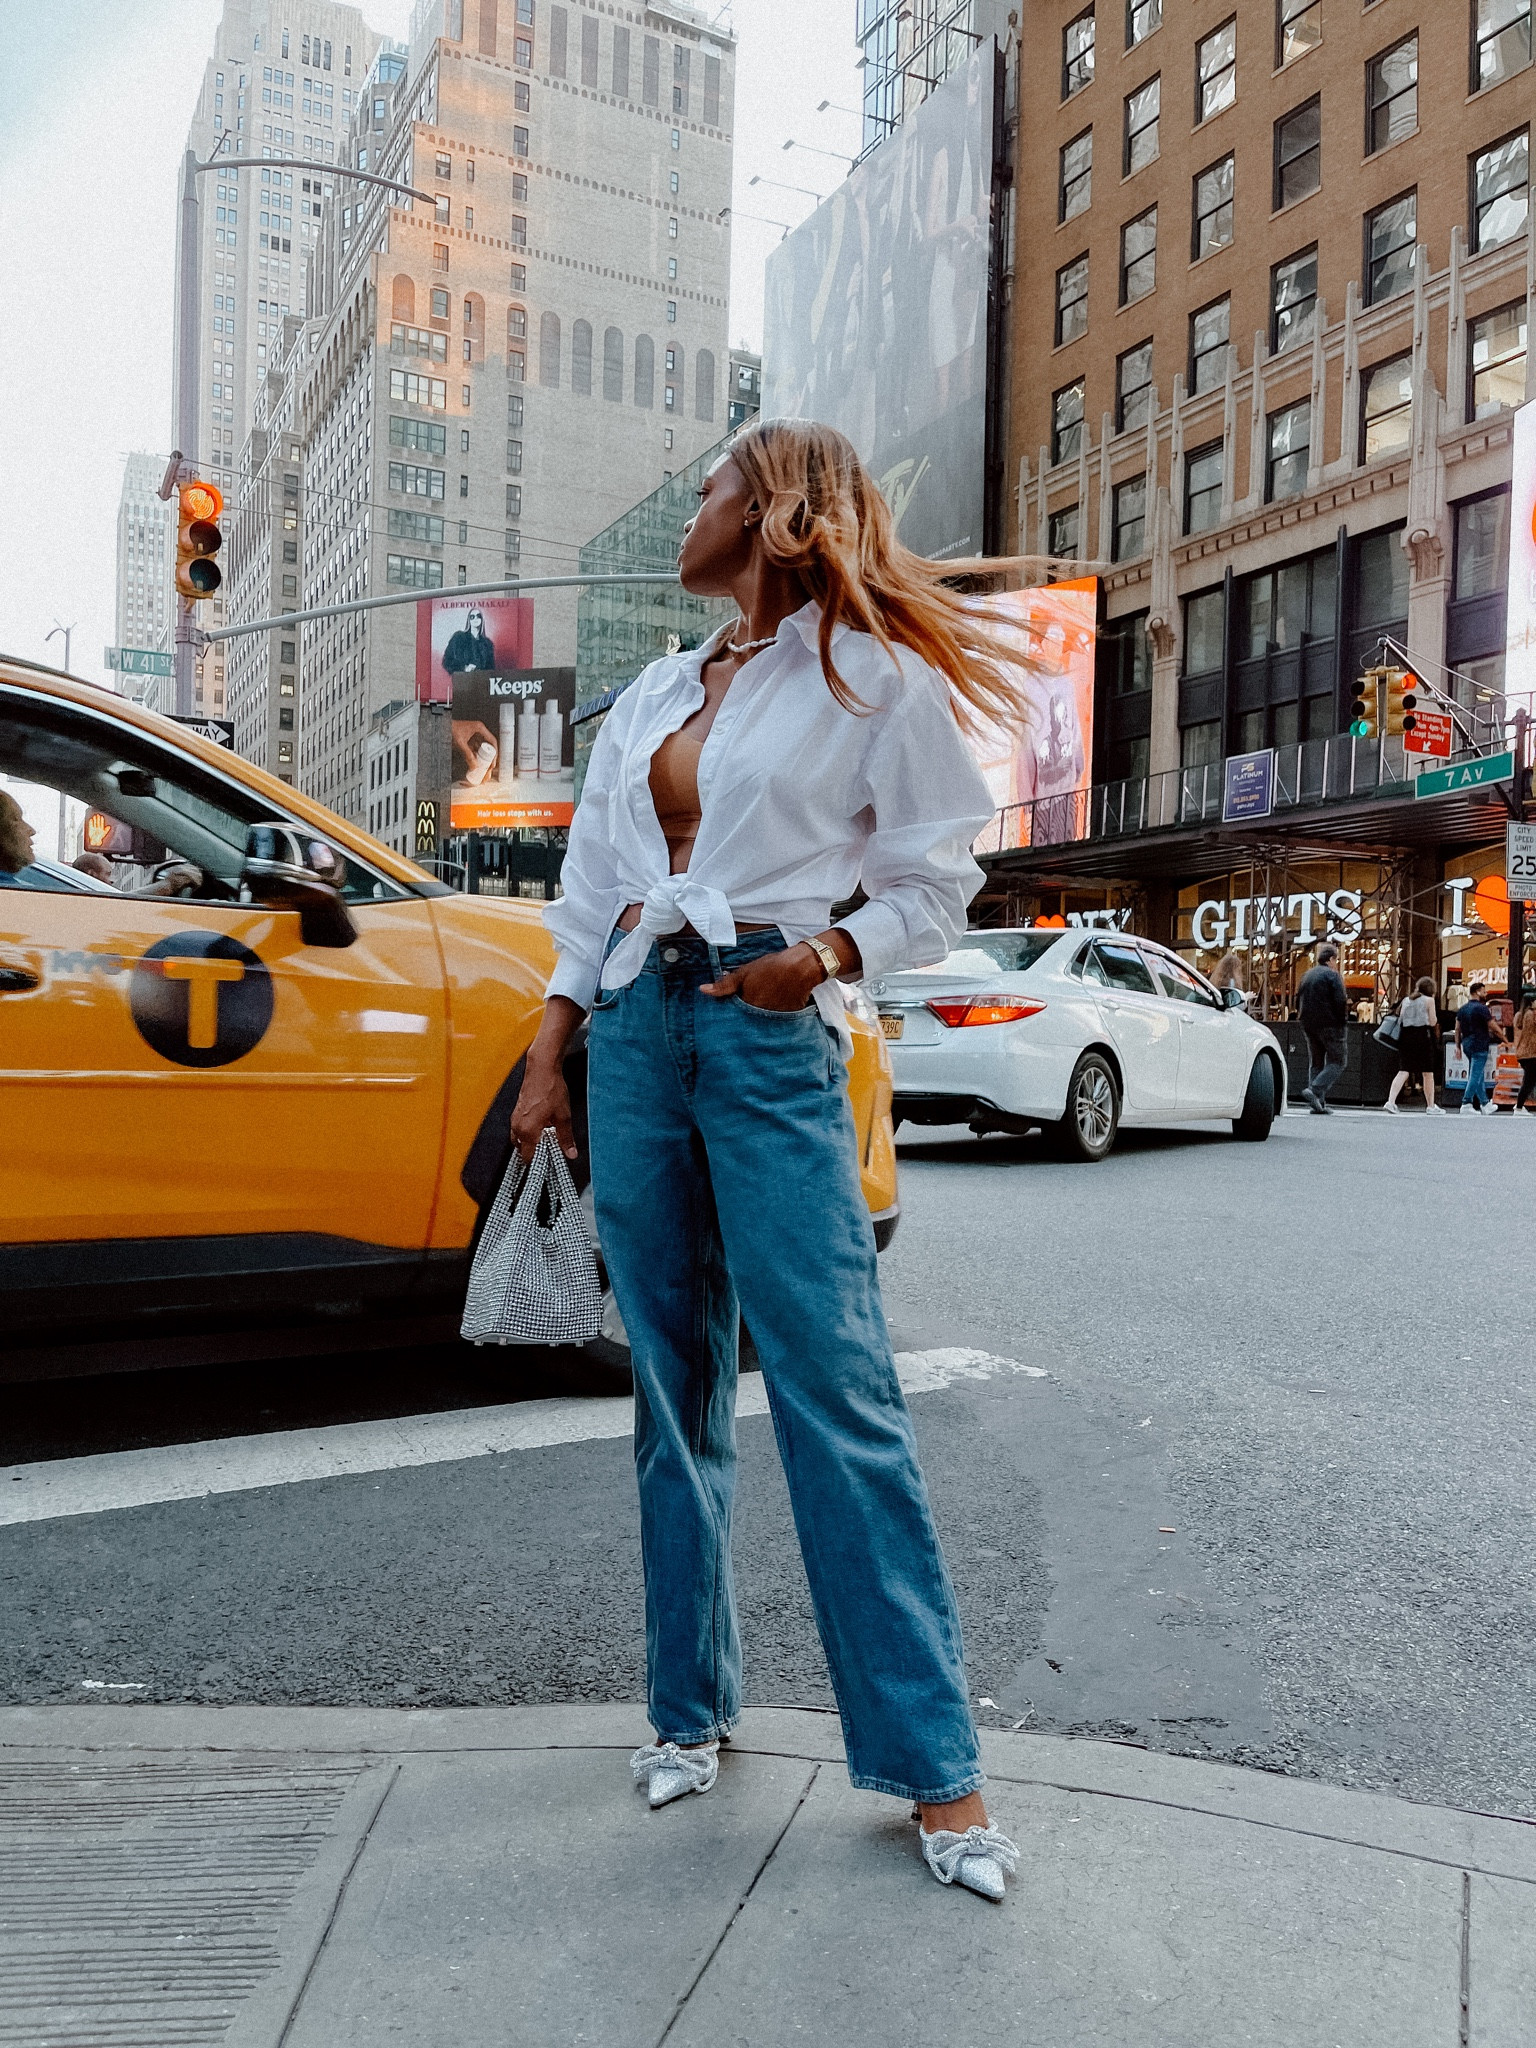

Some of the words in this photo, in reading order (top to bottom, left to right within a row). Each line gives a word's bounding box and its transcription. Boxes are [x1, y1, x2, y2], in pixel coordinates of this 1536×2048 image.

[440, 601, 477, 609] ALBERTO
[122, 651, 134, 670] W
[140, 653, 155, 672] 41
[489, 677, 543, 700] Keeps
[192, 726, 220, 741] WAY
[1427, 731, 1445, 743] Sunday
[1232, 770, 1264, 781] PLATINUM
[1445, 770, 1455, 788] 7
[477, 809, 491, 818] Hair
[492, 809, 506, 817] loss
[507, 809, 526, 819] stops
[527, 808, 542, 817] with
[1517, 826, 1532, 834] CITY
[1514, 835, 1534, 844] SPEED
[1516, 844, 1532, 852] LIMIT
[1512, 854, 1536, 876] 25
[1192, 888, 1363, 949] GIFTS
[163, 955, 245, 1049] T
[881, 1020, 900, 1034] 739C
